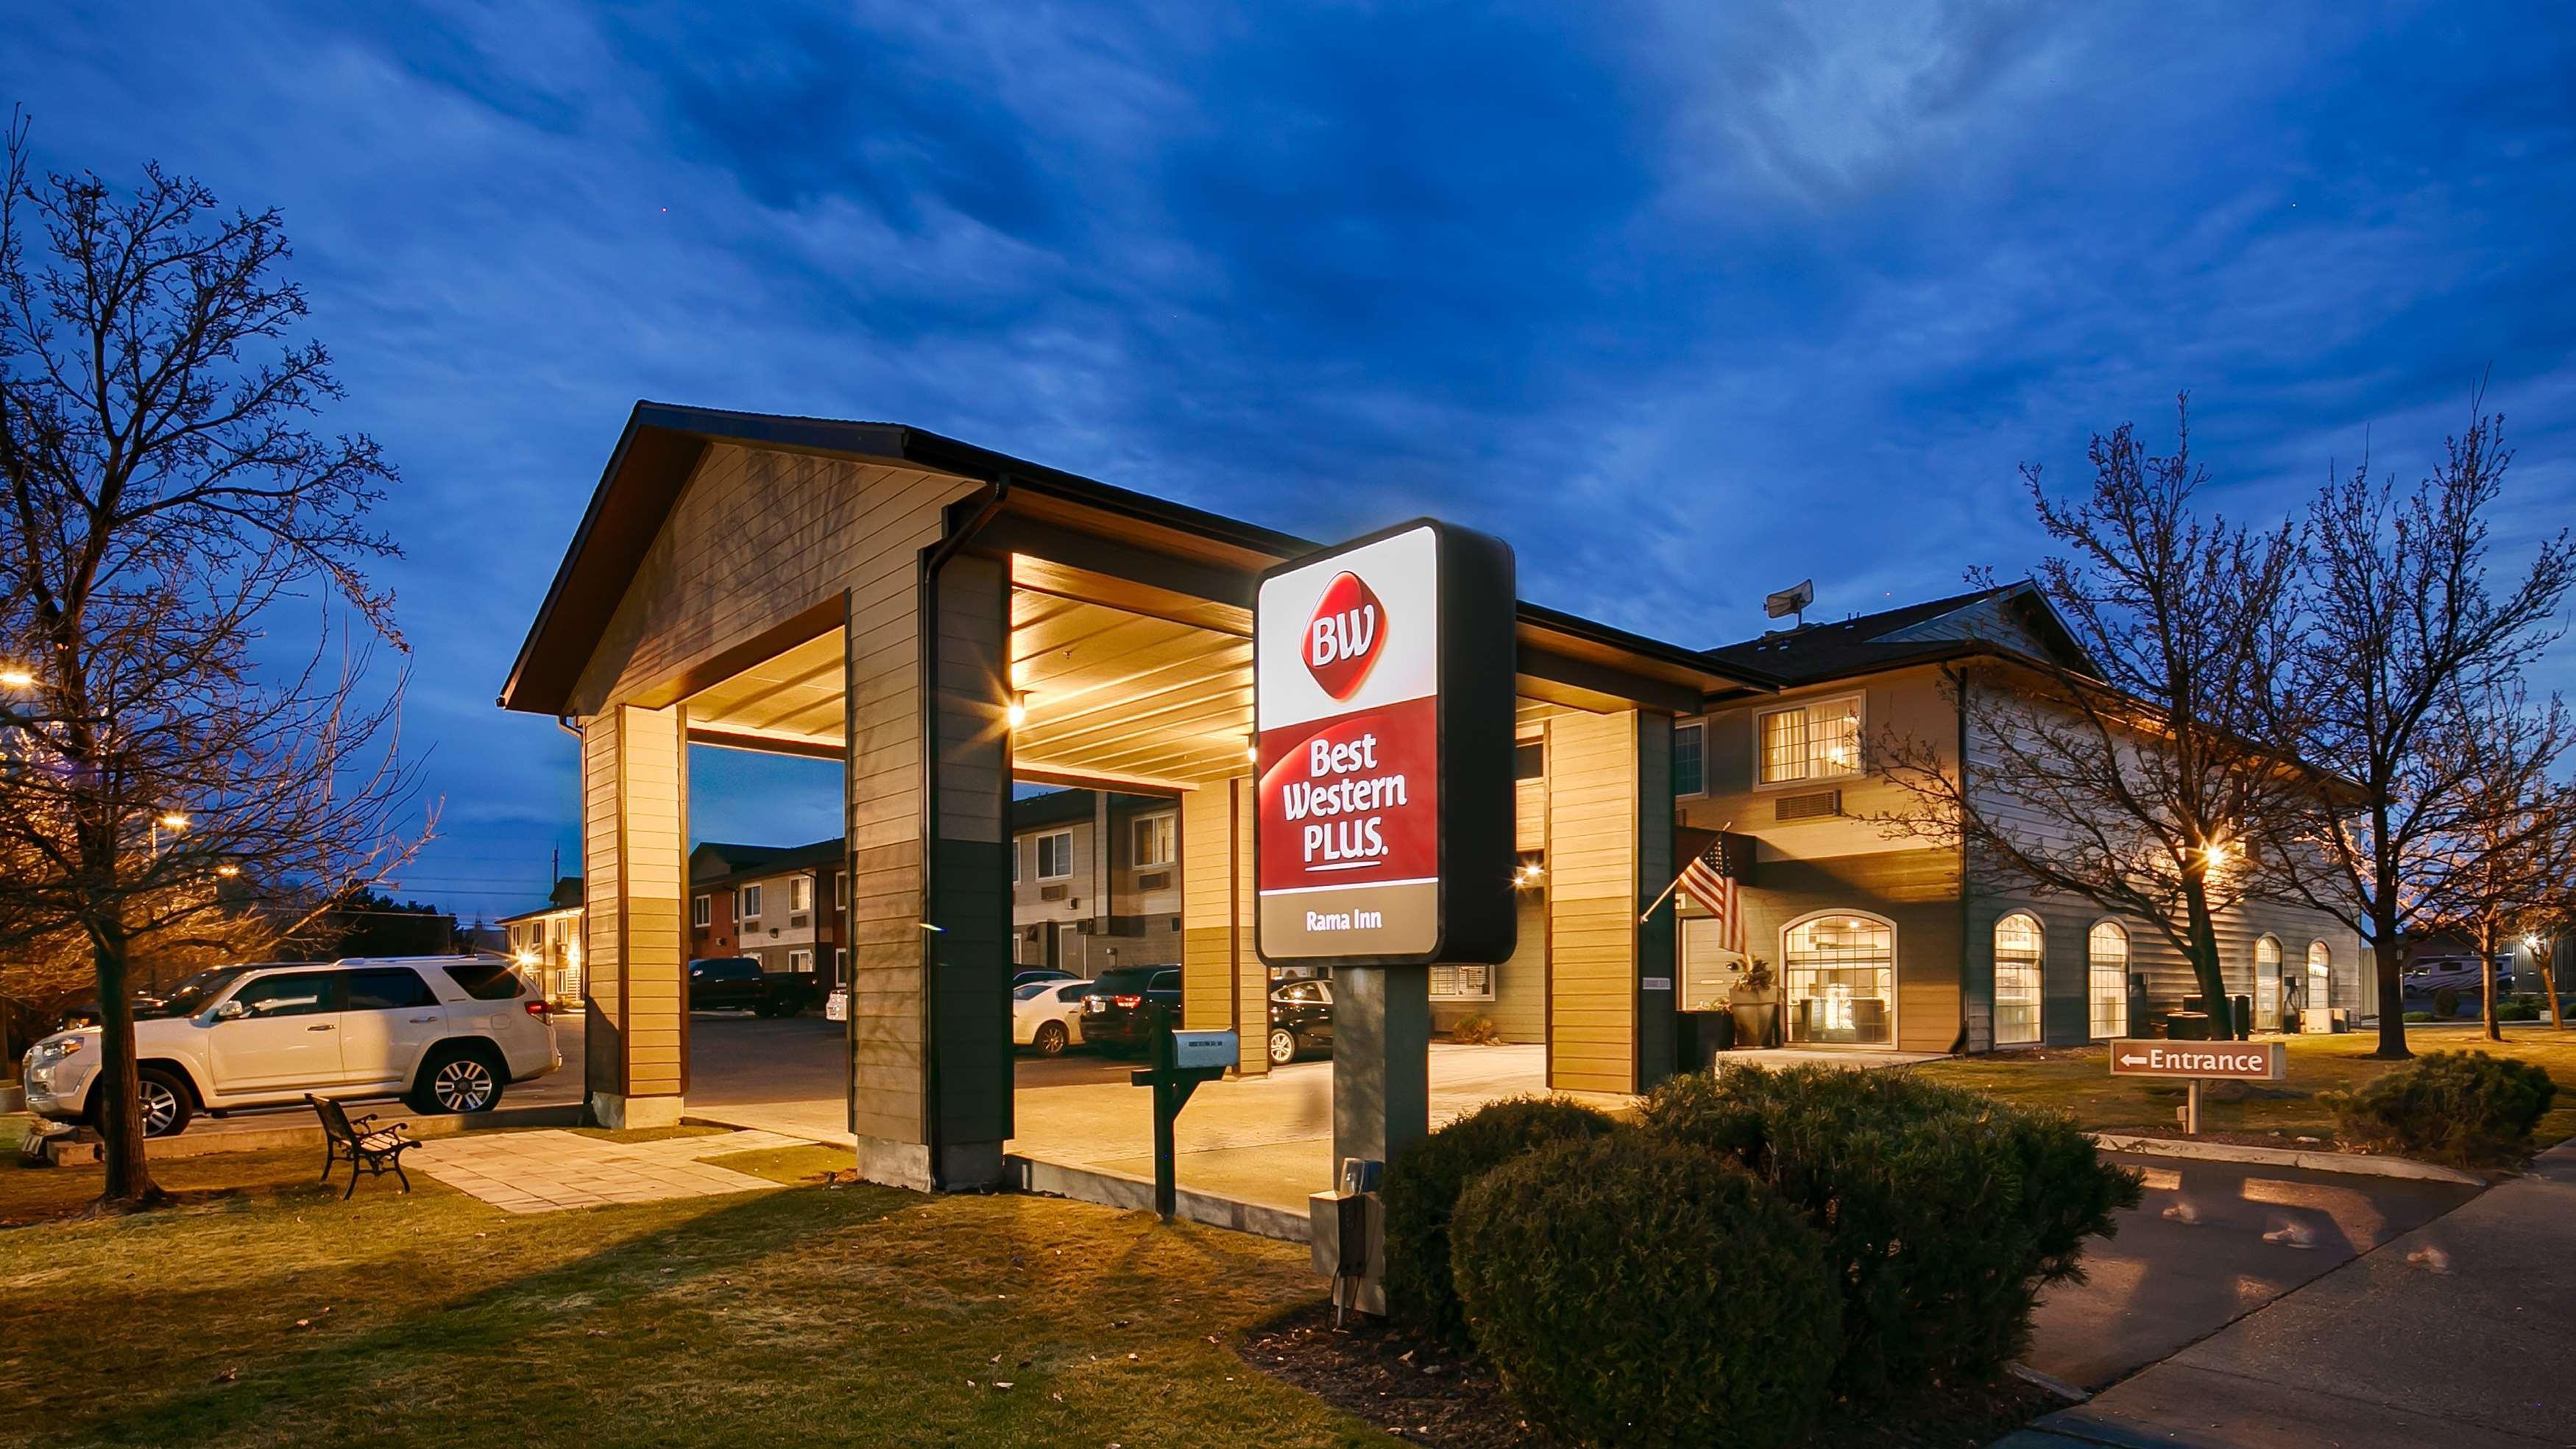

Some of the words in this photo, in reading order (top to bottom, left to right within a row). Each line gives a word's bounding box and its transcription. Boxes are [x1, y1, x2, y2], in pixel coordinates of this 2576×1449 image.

[1312, 604, 1374, 666] BW
[1311, 734, 1377, 777] Best
[1283, 774, 1407, 821] Western
[1306, 911, 1351, 932] Rama
[1354, 908, 1382, 929] Inn
[2151, 1049, 2263, 1071] Entrance
